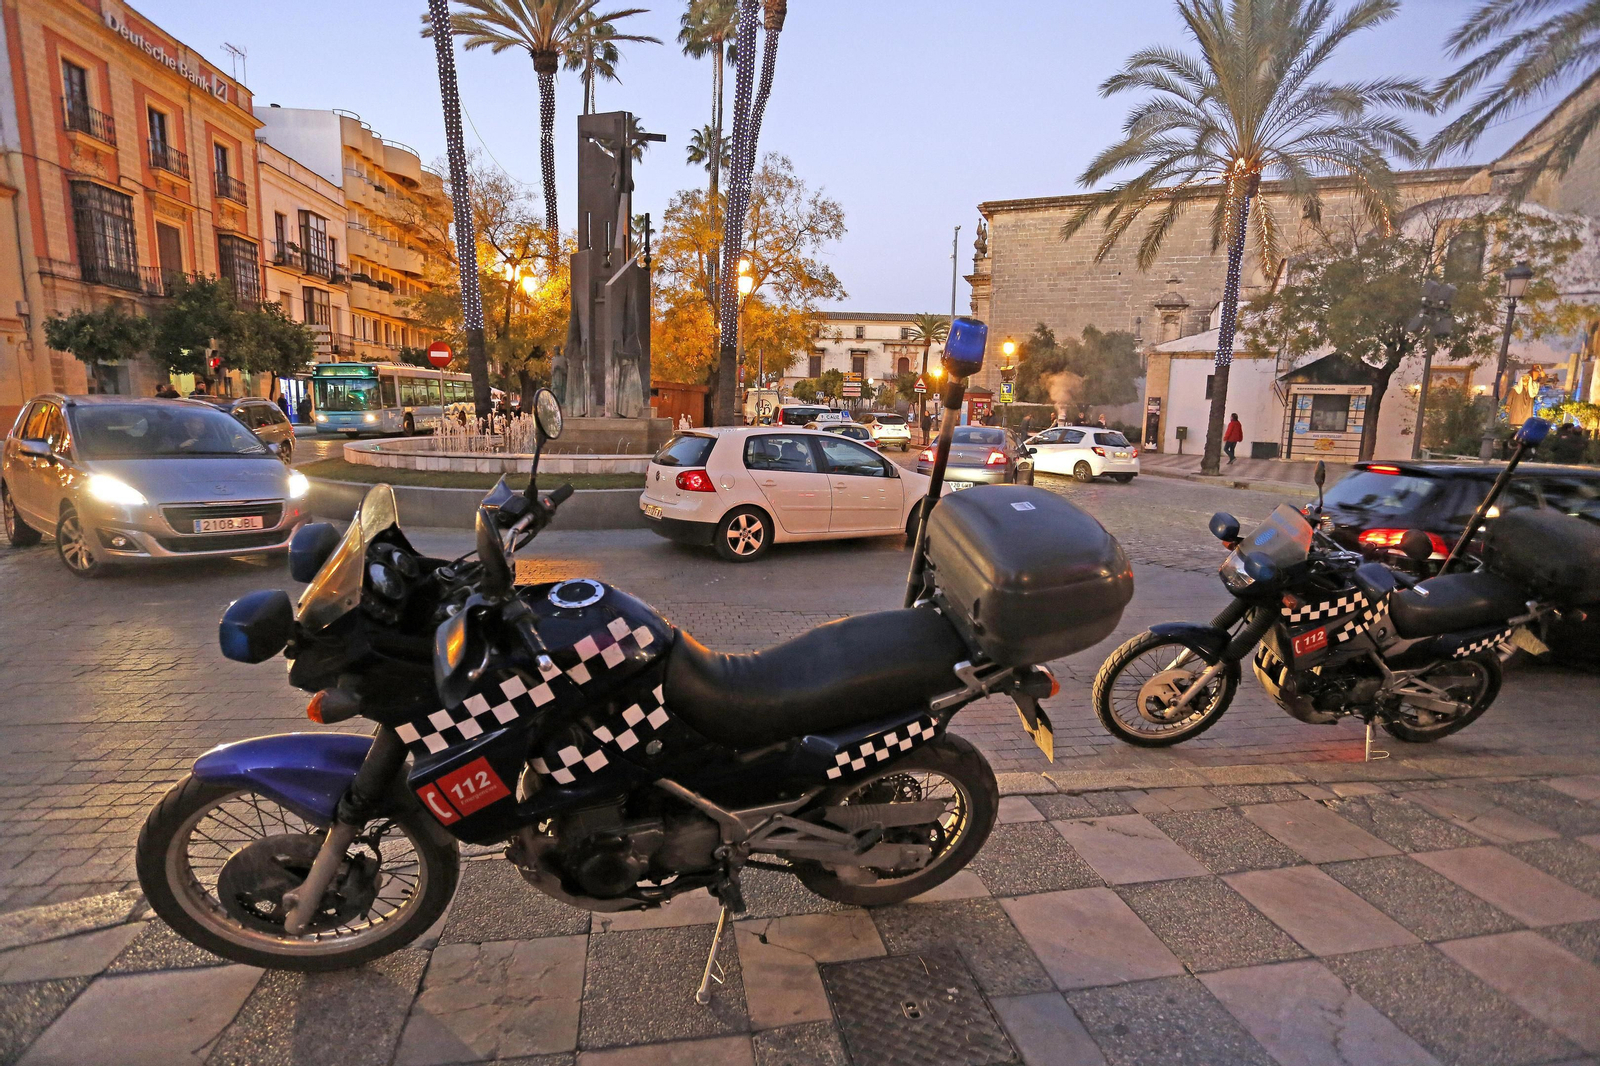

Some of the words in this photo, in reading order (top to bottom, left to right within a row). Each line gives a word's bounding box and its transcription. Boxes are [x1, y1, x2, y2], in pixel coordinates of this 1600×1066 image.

[104, 11, 176, 71] Deutsche
[178, 60, 211, 93] Bank
[203, 519, 234, 531] 2108
[236, 518, 257, 528] JBL
[1304, 631, 1324, 646] 112
[451, 771, 491, 799] 112
[461, 784, 498, 805] Emergencias
